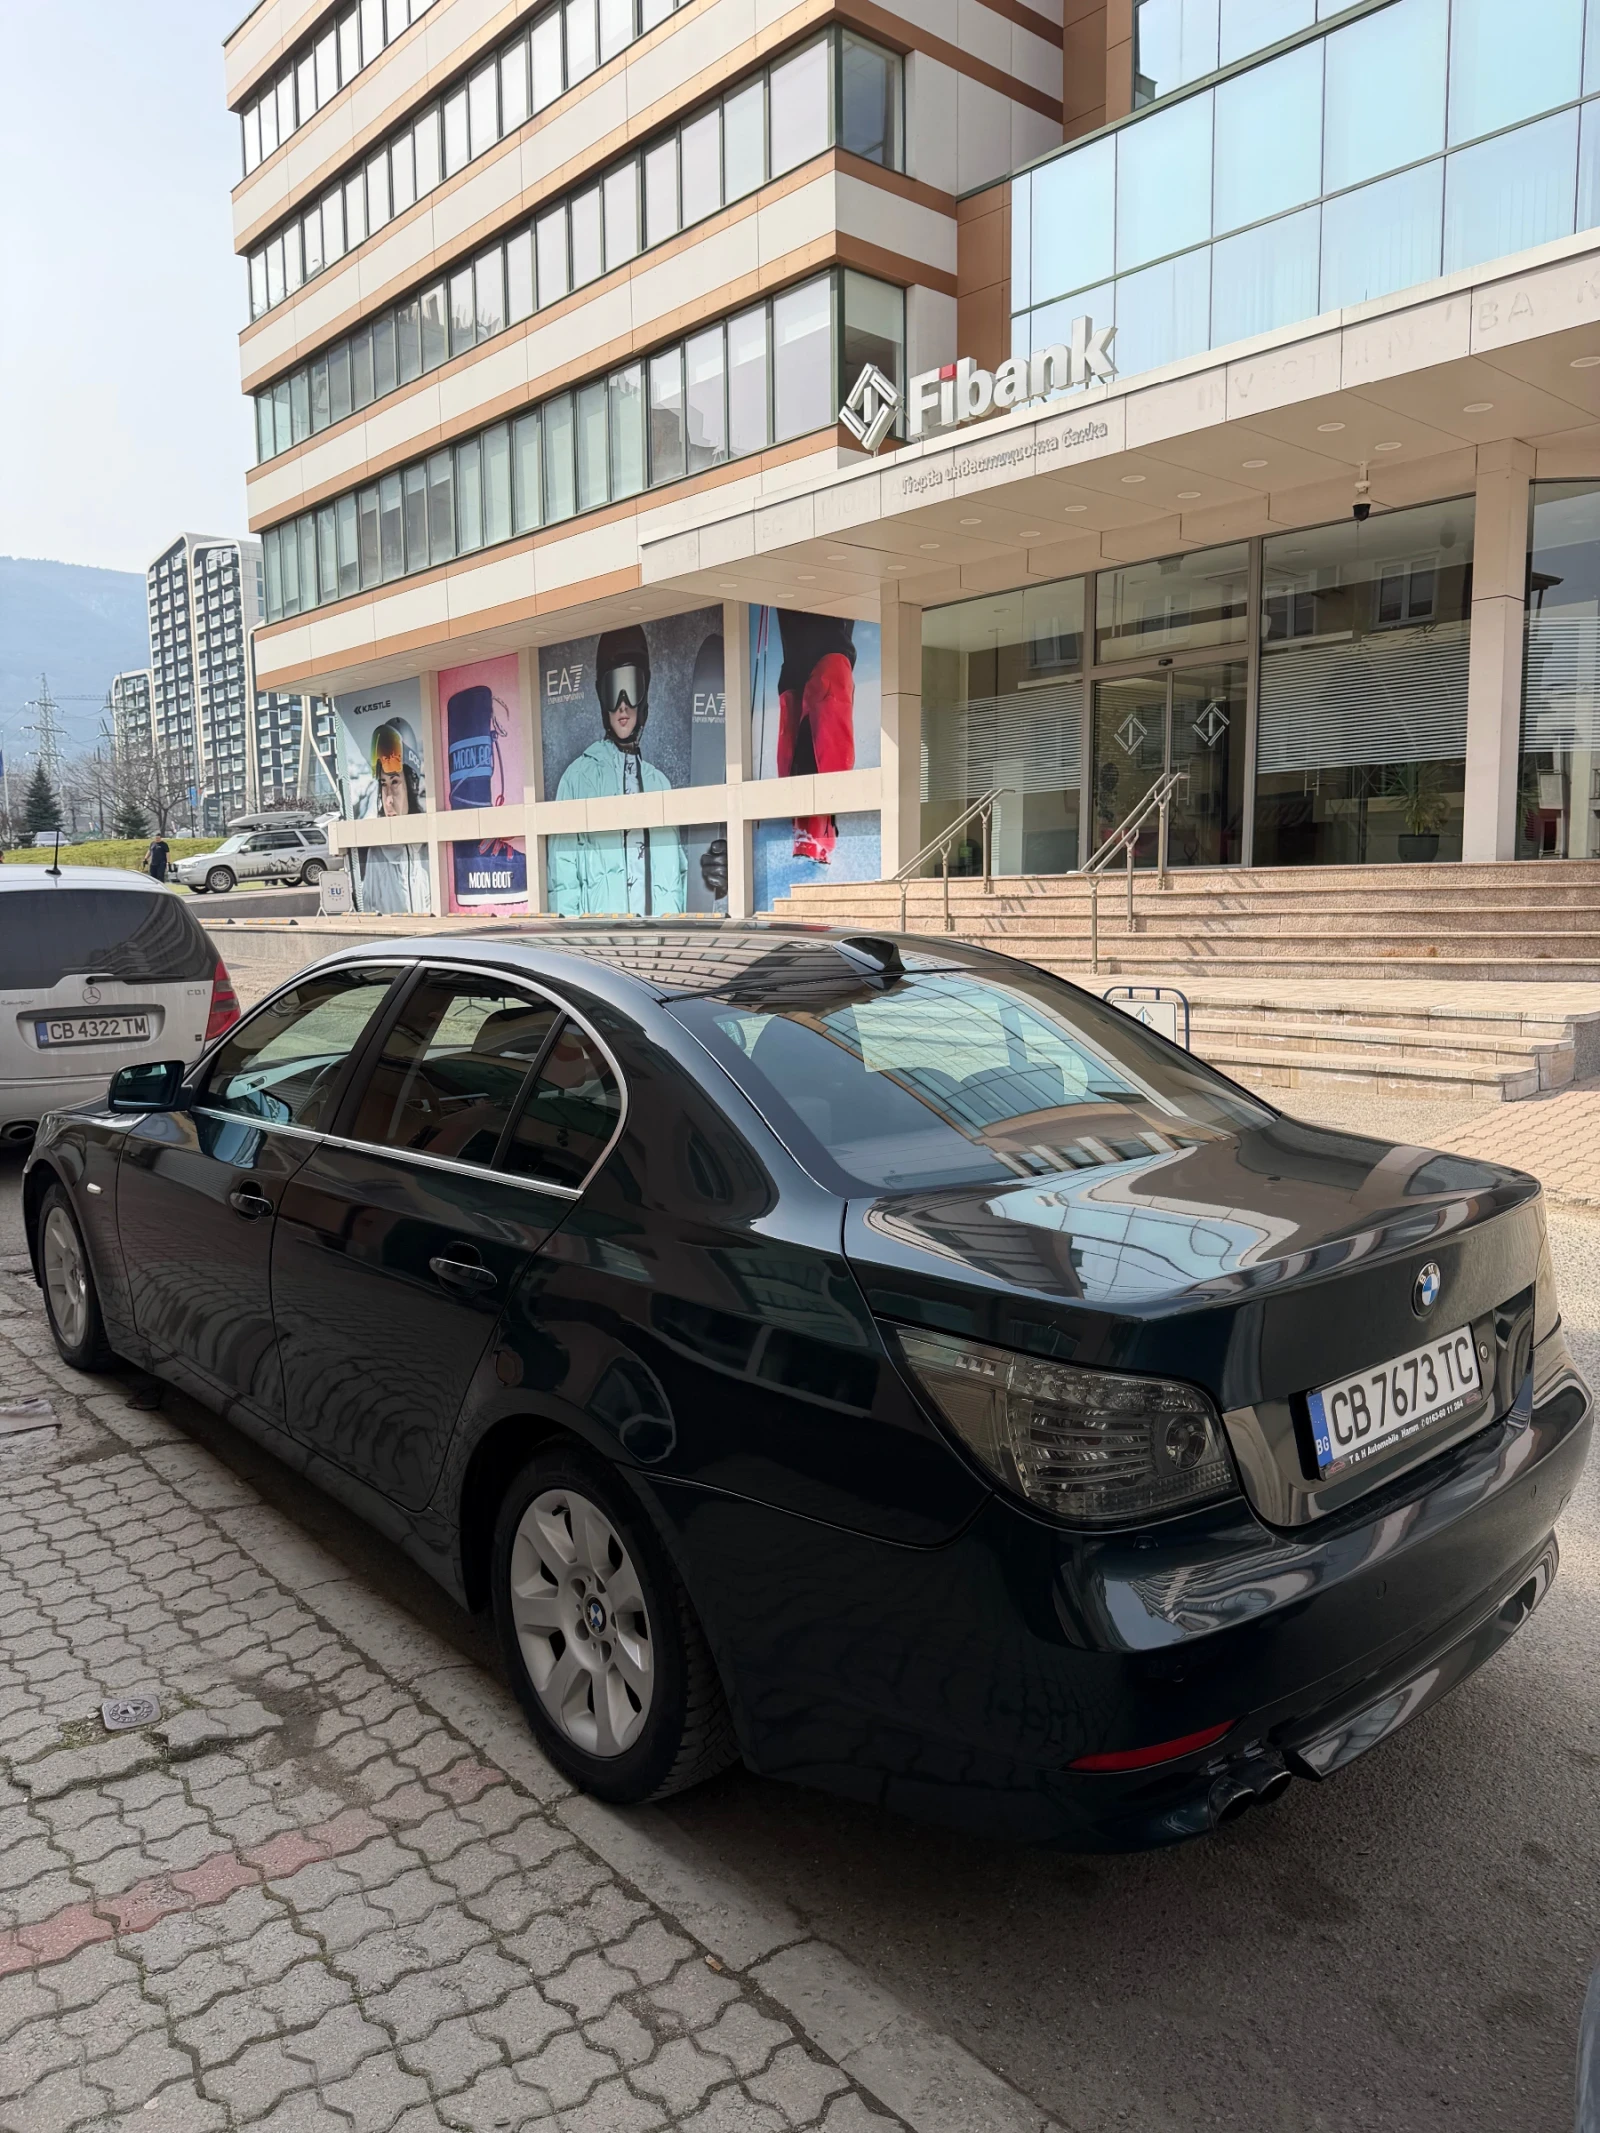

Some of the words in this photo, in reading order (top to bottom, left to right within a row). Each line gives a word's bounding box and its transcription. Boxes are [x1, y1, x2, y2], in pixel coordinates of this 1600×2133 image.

[909, 315, 1119, 438] Fibank
[1061, 421, 1109, 448] банка
[546, 663, 584, 697] EA7
[693, 692, 726, 716] EA7
[453, 747, 477, 771] MOON
[330, 887, 342, 895] EU
[468, 871, 491, 889] MOON
[491, 871, 513, 889] BOOT
[50, 1021, 74, 1041] CB
[77, 1020, 120, 1039] 4322
[121, 1017, 147, 1036] TM
[1331, 1384, 1372, 1447] CB
[1372, 1353, 1439, 1429] 7673
[1438, 1336, 1473, 1393] TC
[1316, 1435, 1330, 1456] BG
[1354, 1453, 1361, 1462] &
